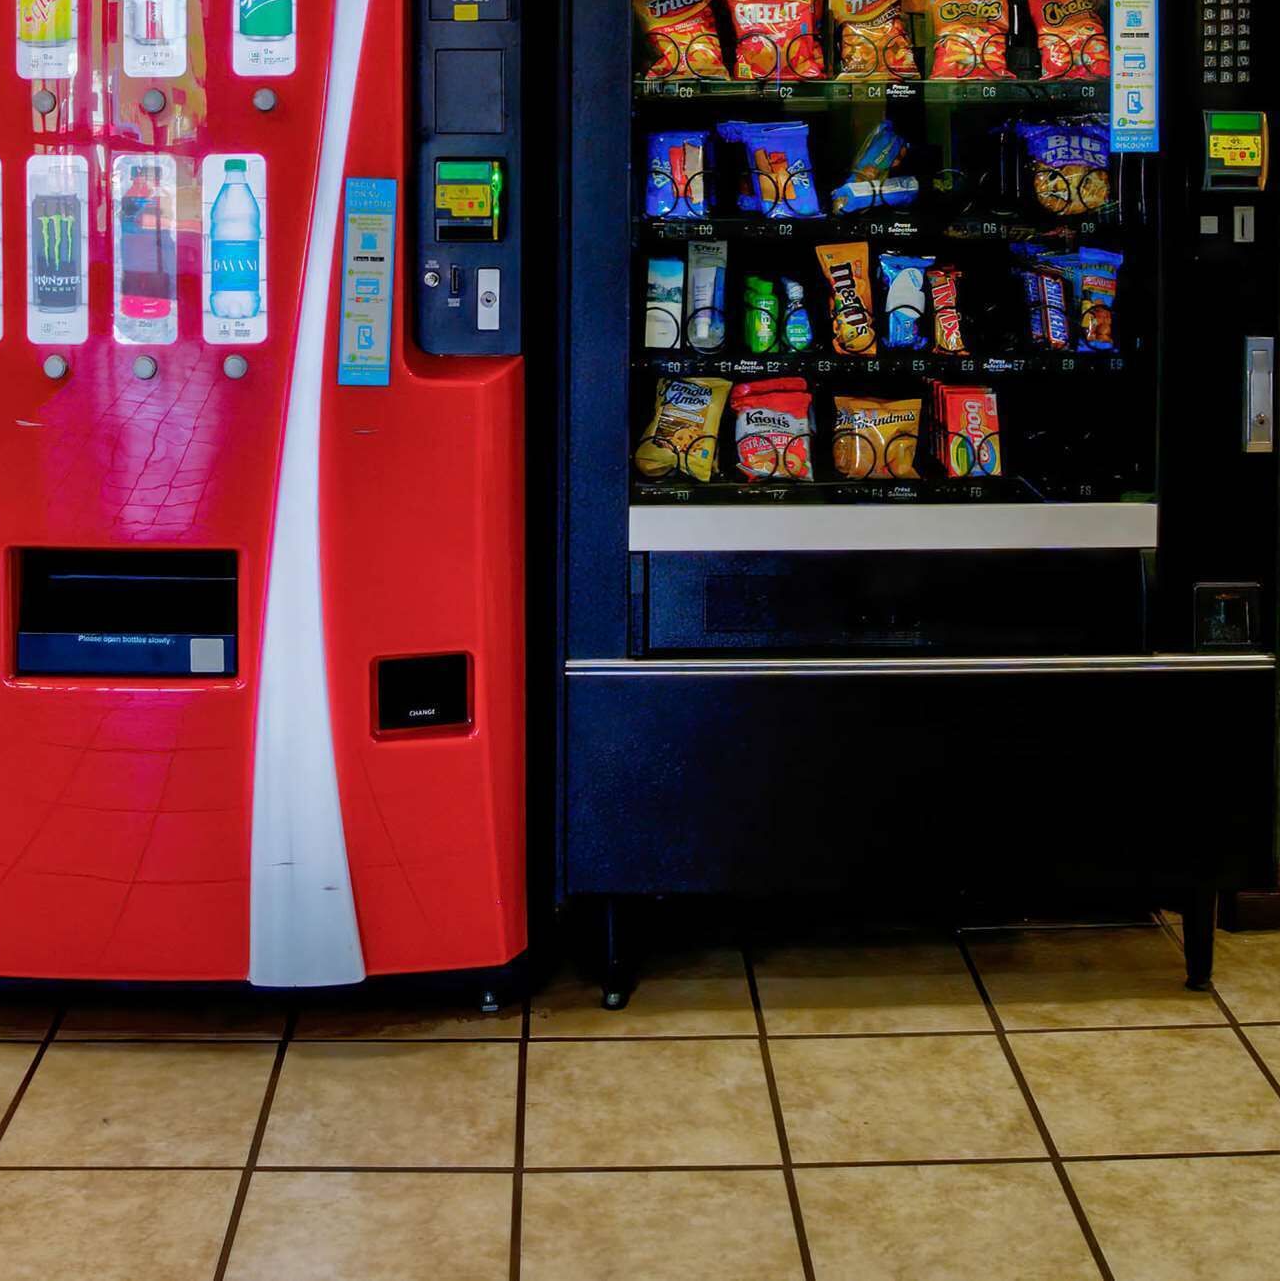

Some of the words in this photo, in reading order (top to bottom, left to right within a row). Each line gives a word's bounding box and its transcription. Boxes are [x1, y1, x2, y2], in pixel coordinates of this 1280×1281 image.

[940, 0, 1003, 22] Cheetos
[679, 87, 693, 98] C0
[780, 87, 793, 98] C2
[868, 87, 881, 97] C4
[982, 87, 996, 97] C6
[1046, 135, 1100, 152] BIG
[1042, 146, 1107, 168] TEXAS
[779, 224, 792, 235] D2
[871, 224, 883, 234] D4
[983, 223, 997, 233] D6
[1081, 222, 1096, 232] D8
[35, 275, 80, 284] MONSTER
[932, 278, 962, 341] TWIX
[720, 361, 732, 372] E1
[767, 361, 779, 372] E2
[818, 361, 831, 372] E3
[867, 361, 880, 371] E4
[912, 360, 925, 371] E5
[961, 360, 974, 371] E6
[1013, 360, 1025, 370] E7
[1062, 359, 1074, 370] E8
[659, 379, 712, 397] Famous
[669, 391, 708, 406] Amos
[746, 410, 790, 428] Knott's
[79, 634, 101, 642] Please
[122, 636, 147, 644] bottles
[148, 637, 170, 645] slowly
